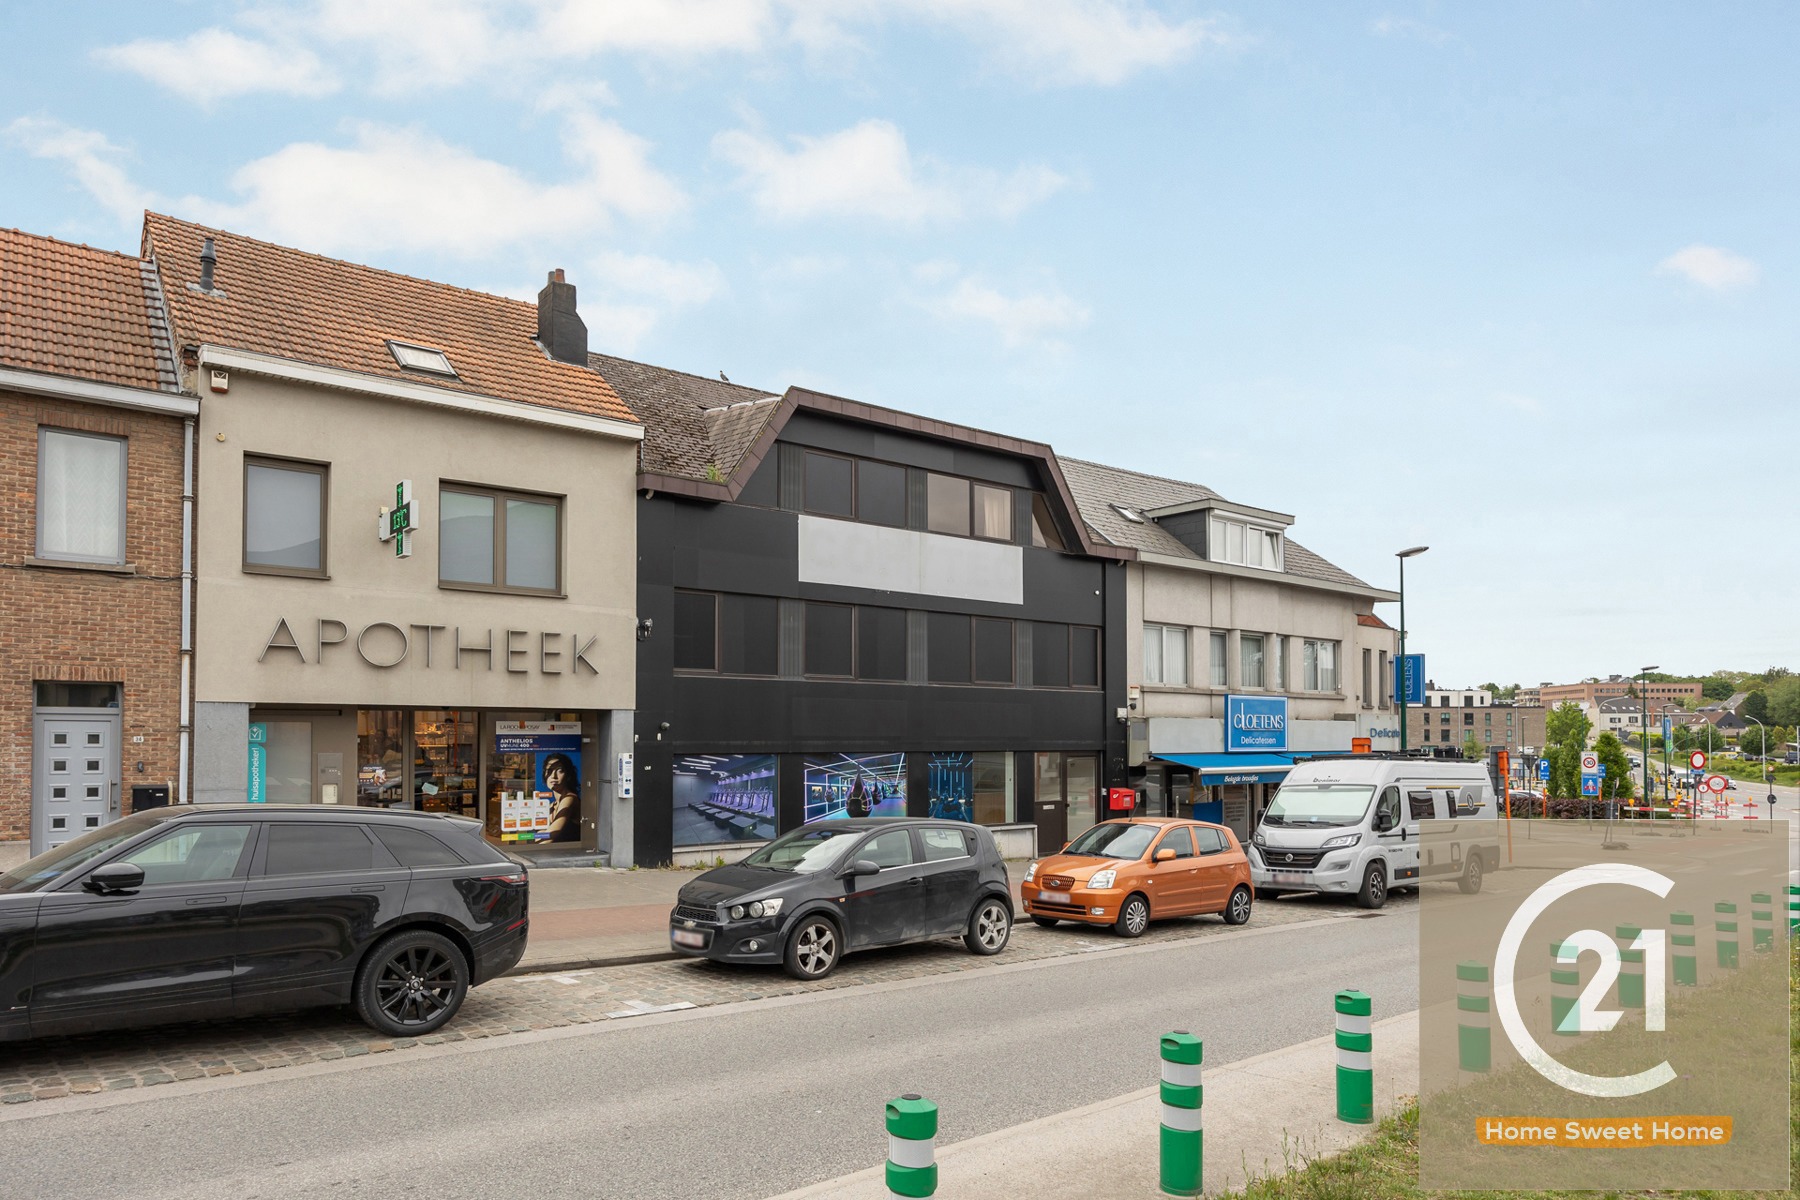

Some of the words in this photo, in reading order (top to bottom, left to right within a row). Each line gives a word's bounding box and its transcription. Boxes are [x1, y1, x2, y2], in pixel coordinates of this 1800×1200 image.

[258, 616, 600, 675] APOTHEEK
[1233, 702, 1284, 731] CLOETENS
[1240, 736, 1277, 745] Delicatessen
[1540, 760, 1548, 771] P
